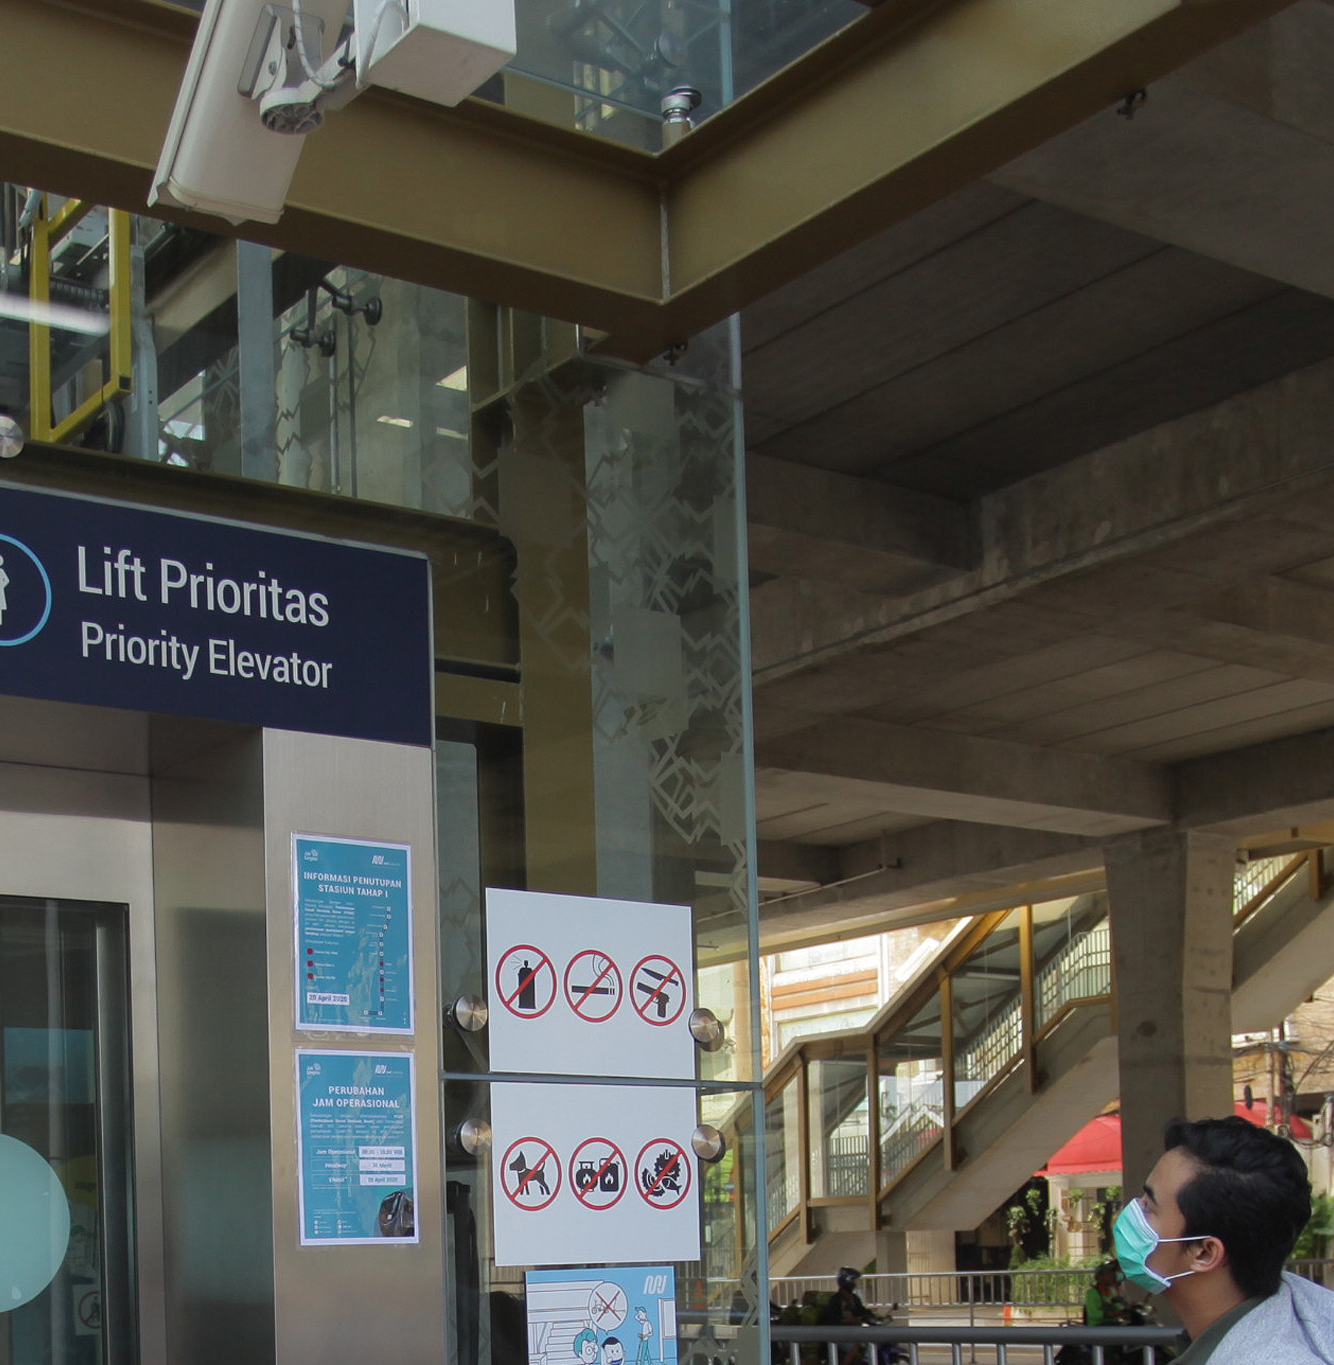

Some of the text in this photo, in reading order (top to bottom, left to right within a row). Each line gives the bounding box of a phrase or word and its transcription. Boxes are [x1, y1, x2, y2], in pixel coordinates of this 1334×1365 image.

[78, 546, 329, 627] Lift Prioritas
[82, 621, 333, 689] Priority Elevator
[303, 871, 402, 888] INFORMASI PENUTUPAN
[318, 884, 355, 895] STASIUN
[356, 887, 383, 898] TAHAP
[317, 994, 332, 1004] April
[328, 1085, 385, 1096] PERUBAHAN
[312, 1098, 400, 1109] JAM OPERASIONAL
